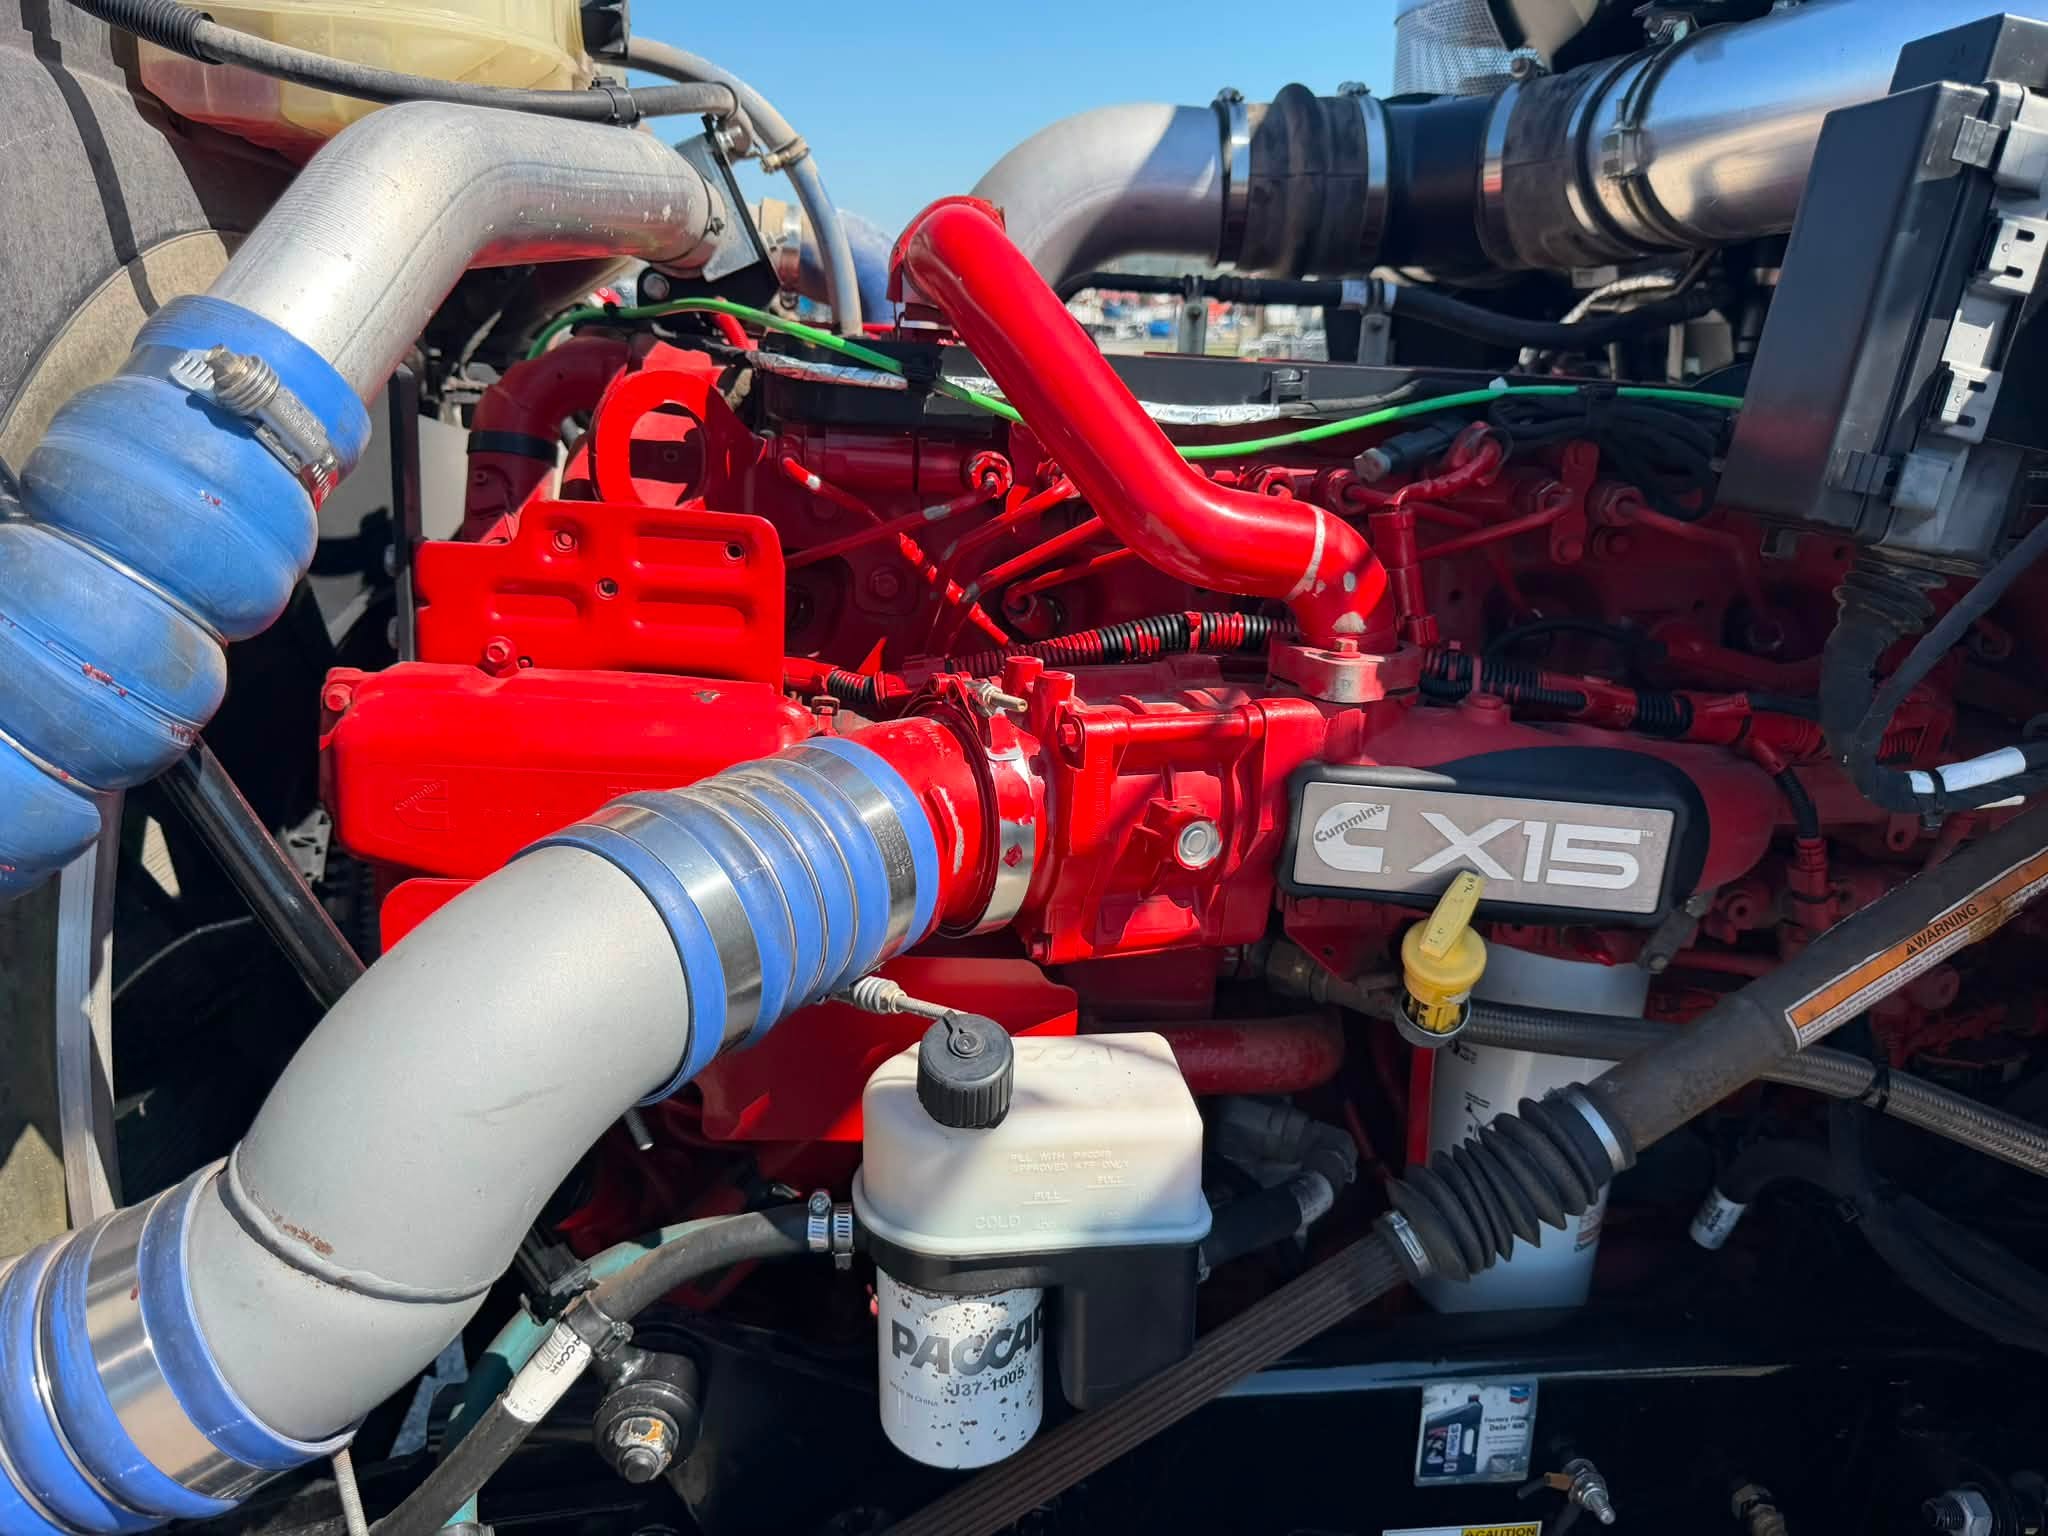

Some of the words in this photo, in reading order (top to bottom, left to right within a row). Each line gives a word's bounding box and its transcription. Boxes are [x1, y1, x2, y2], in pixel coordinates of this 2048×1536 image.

[1315, 805, 1385, 842] Cummins
[1408, 811, 1641, 890] X15
[1913, 903, 1979, 949] WARNING
[550, 1338, 582, 1376] ACCAR
[1476, 1527, 1535, 1536] CAUTION
